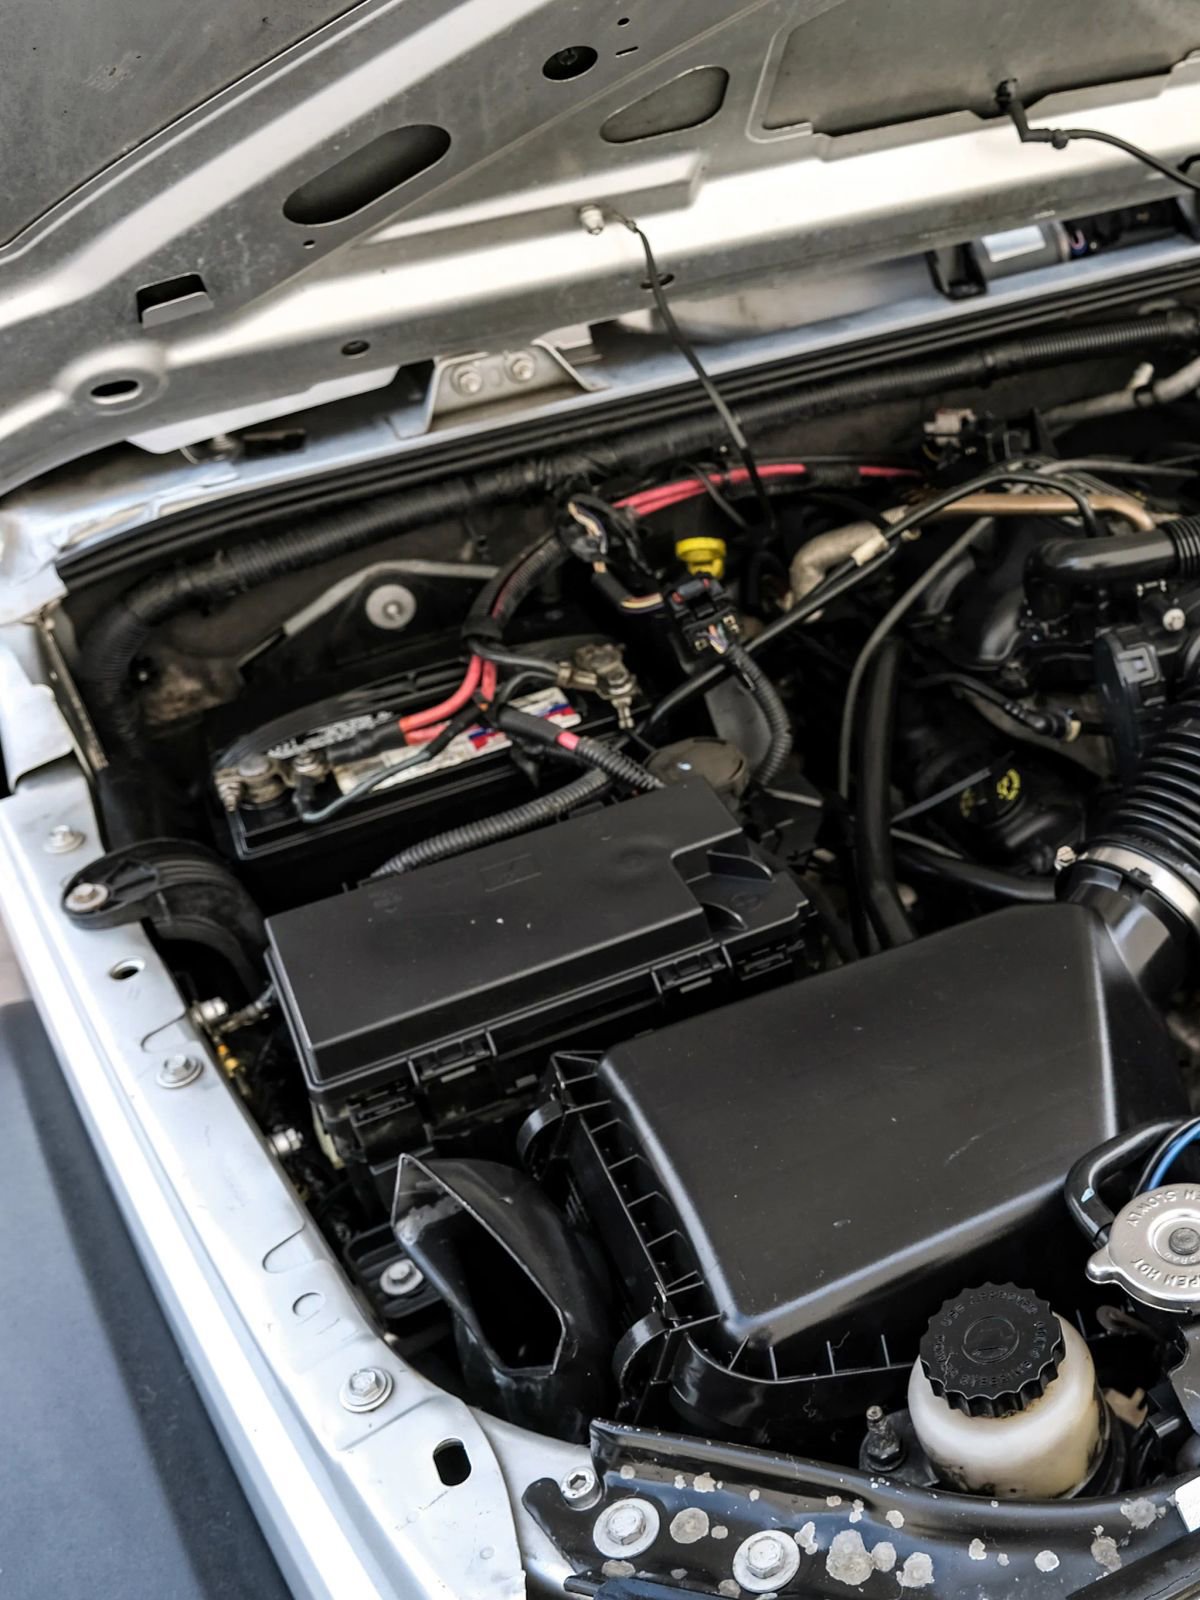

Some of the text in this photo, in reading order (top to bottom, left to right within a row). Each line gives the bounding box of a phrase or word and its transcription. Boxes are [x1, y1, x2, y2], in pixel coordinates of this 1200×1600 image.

[1126, 1190, 1178, 1227] SLOWLY
[1130, 1256, 1162, 1281] HOT
[940, 1289, 1038, 1327] USE APPROVED
[959, 1359, 1033, 1387] STEERING
